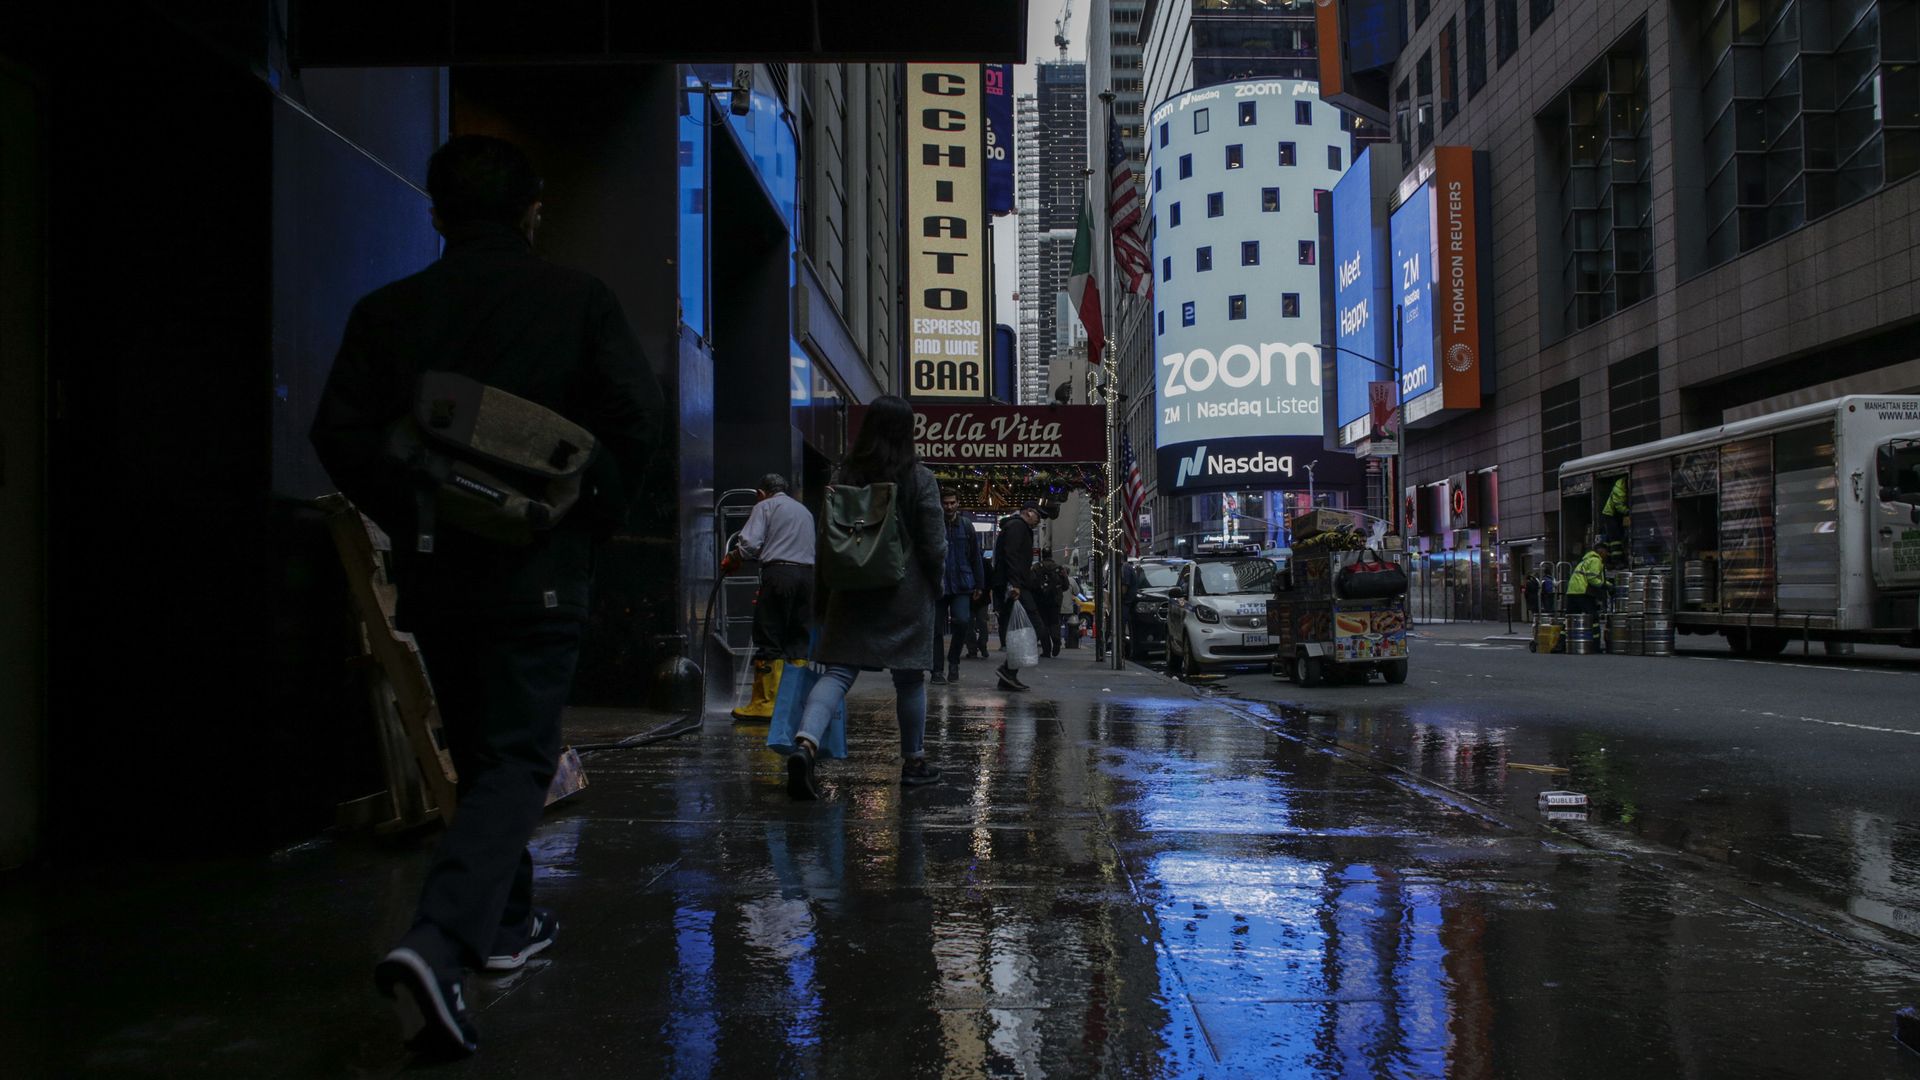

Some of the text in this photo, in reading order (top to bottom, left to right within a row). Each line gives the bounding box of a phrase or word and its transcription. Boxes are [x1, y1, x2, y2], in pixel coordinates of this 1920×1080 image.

[1191, 90, 1220, 103] Nasdaq
[1235, 83, 1282, 97] zoom
[922, 72, 968, 311] CCHIATO
[1339, 250, 1361, 293] Meet
[1403, 253, 1419, 290] ZM
[1449, 181, 1465, 334] THOMSON REUTERS
[914, 318, 980, 336] ESPRESSO
[1340, 298, 1369, 338] Happy.
[914, 338, 941, 355] AND
[914, 359, 980, 392] BAR
[1163, 342, 1320, 397] zoom
[1402, 364, 1427, 395] zoom
[1164, 396, 1319, 425] ZM Nasdaq Listed
[1864, 402, 1918, 410] MANHATTAN BEER
[913, 412, 1063, 441] Bella Vita
[914, 442, 1063, 458] RICK OVEN PIZZA
[1207, 451, 1293, 478] Nasdaq
